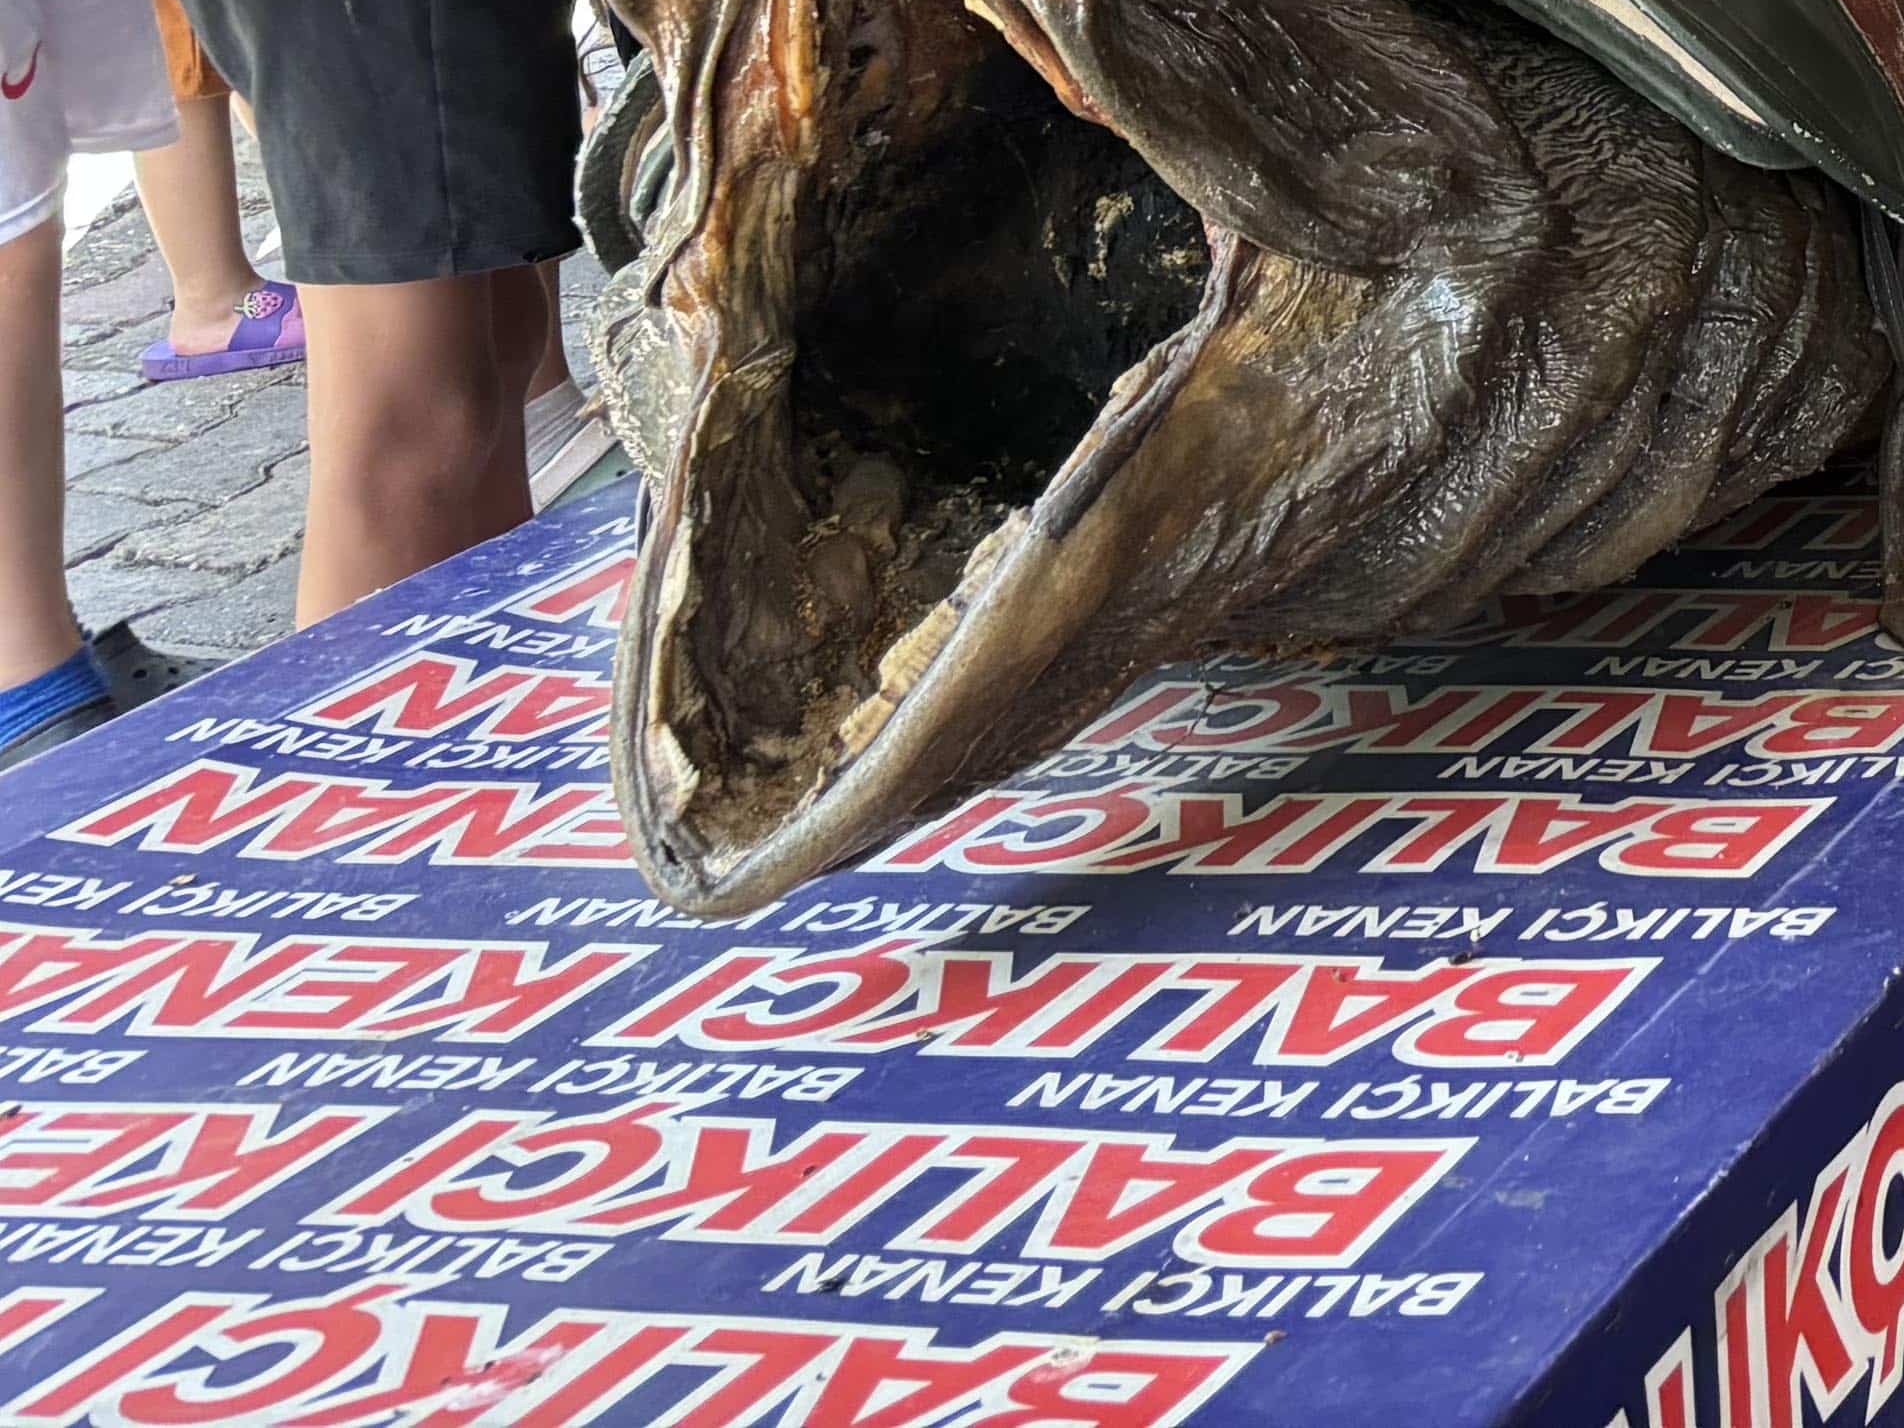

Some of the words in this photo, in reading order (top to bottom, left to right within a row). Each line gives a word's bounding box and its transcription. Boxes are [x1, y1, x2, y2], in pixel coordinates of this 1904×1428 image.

[1583, 655, 1824, 682] KENAN
[165, 716, 405, 764] KENAN
[1437, 754, 1697, 786] KENAN
[46, 757, 640, 869] ENAN
[854, 777, 1838, 879] BALIKÇI
[119, 876, 421, 921] BALIKÇI
[779, 894, 1093, 936] BALIKÇI
[1227, 902, 1513, 943] KENAN
[1518, 901, 1838, 943] BALIKÇI
[580, 932, 1663, 1067] BALIKÇI
[234, 1050, 524, 1093] KENAN
[531, 1052, 866, 1103] BALIKÇI
[1007, 1070, 1321, 1119] KENAN
[1321, 1071, 1673, 1119] BALIKÇI
[299, 1094, 1479, 1268] BALIKÇI
[248, 1226, 616, 1283] BALIKÇI
[761, 1251, 1104, 1308] KENAN
[1101, 1264, 1486, 1317] BALIKÇI
